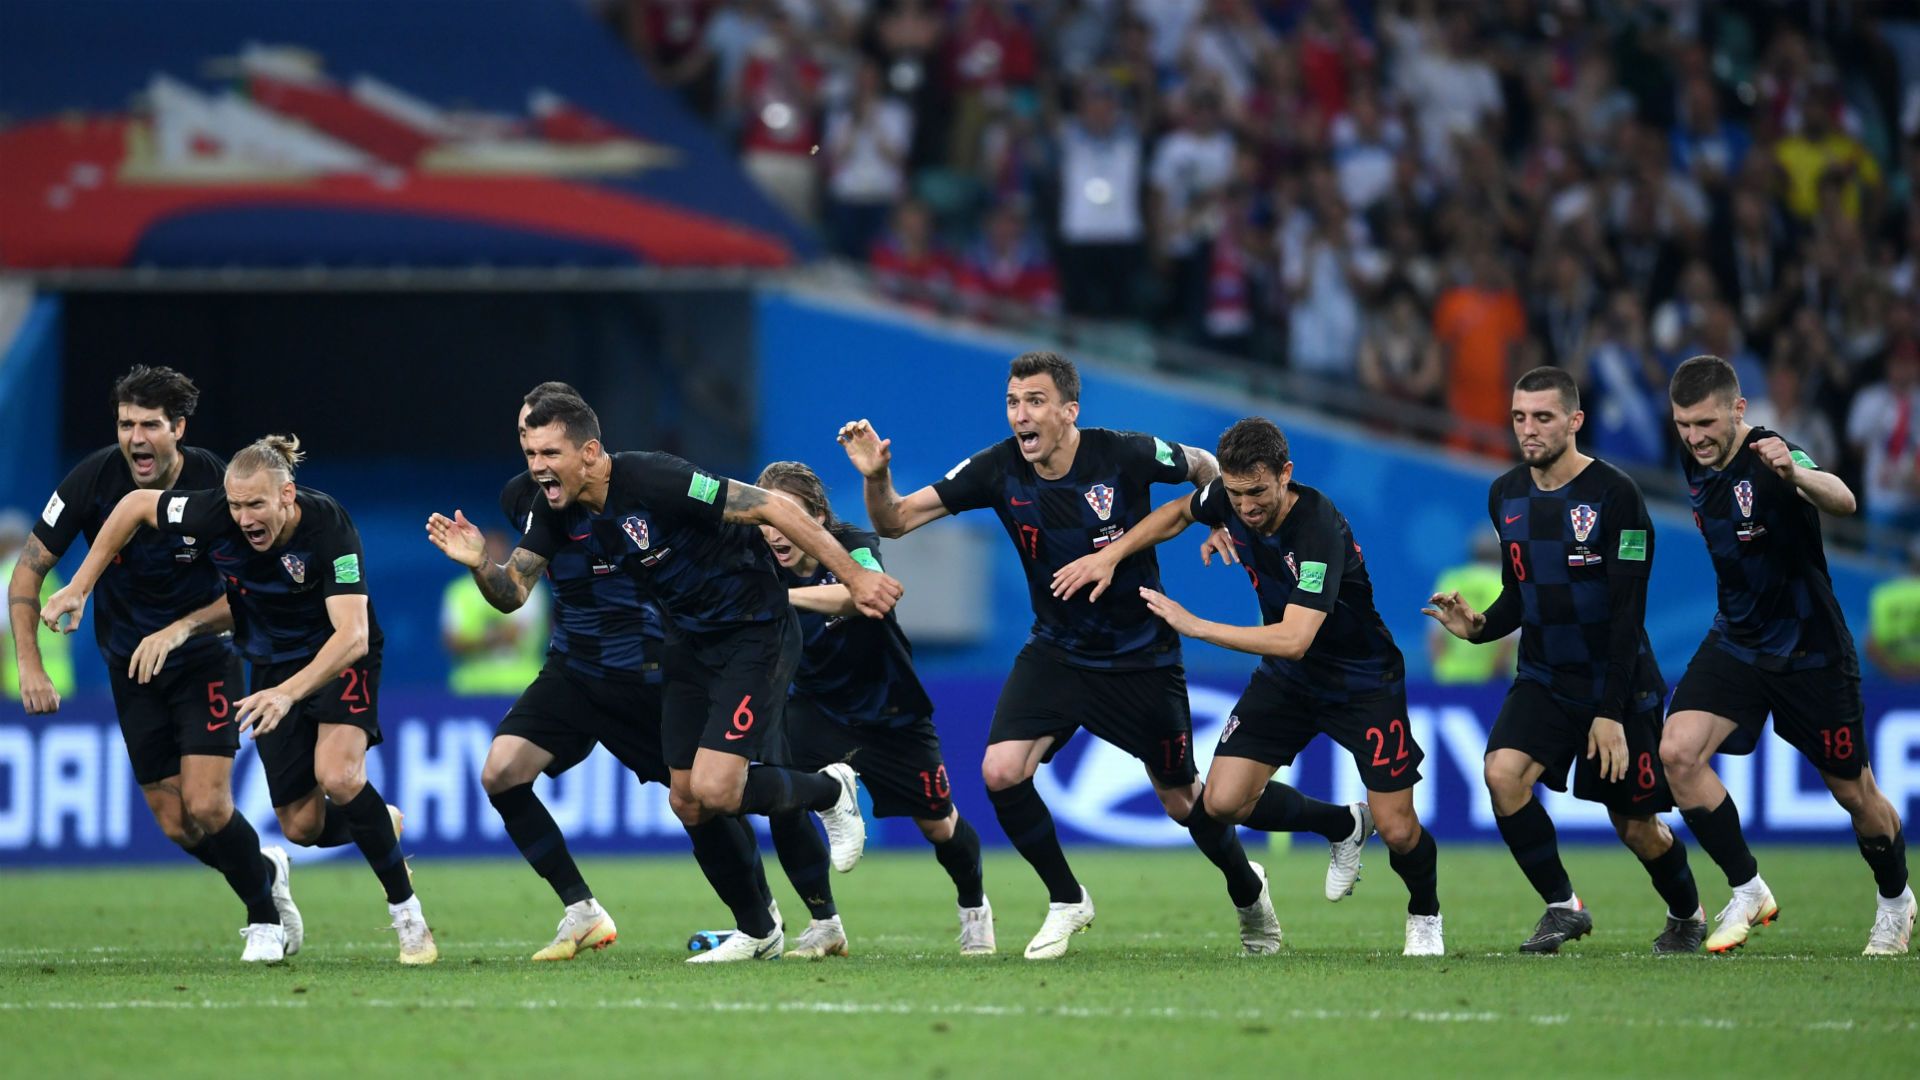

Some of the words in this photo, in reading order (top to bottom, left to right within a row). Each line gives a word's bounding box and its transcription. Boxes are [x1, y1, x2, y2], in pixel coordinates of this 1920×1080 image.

[1510, 542, 1526, 581] 8
[208, 681, 228, 719] 5
[733, 695, 754, 732] 6
[1366, 719, 1408, 767] 22
[1819, 725, 1853, 760] 18
[919, 764, 950, 798] 10
[1638, 752, 1655, 789] 8
